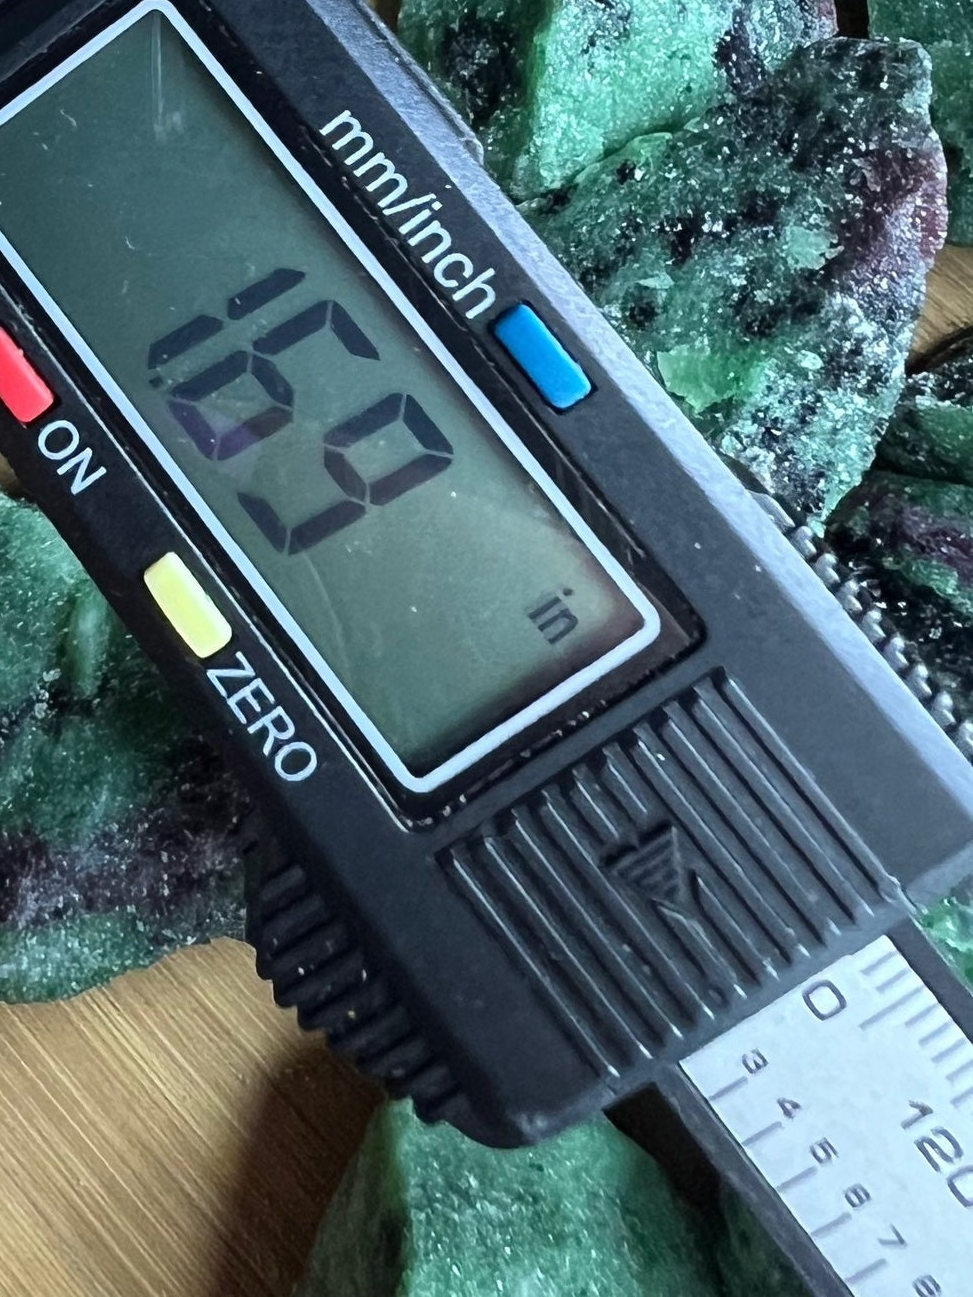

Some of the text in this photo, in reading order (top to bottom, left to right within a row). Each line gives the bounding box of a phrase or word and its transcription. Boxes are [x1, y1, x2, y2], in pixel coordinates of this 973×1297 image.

[319, 109, 497, 320] mm/inch
[37, 419, 107, 495] ON
[528, 588, 578, 644] in
[206, 651, 317, 782] ZERO
[742, 1049, 768, 1074] 3
[776, 1097, 802, 1120] 4
[810, 1138, 838, 1164] 5
[878, 1225, 907, 1248] 7
